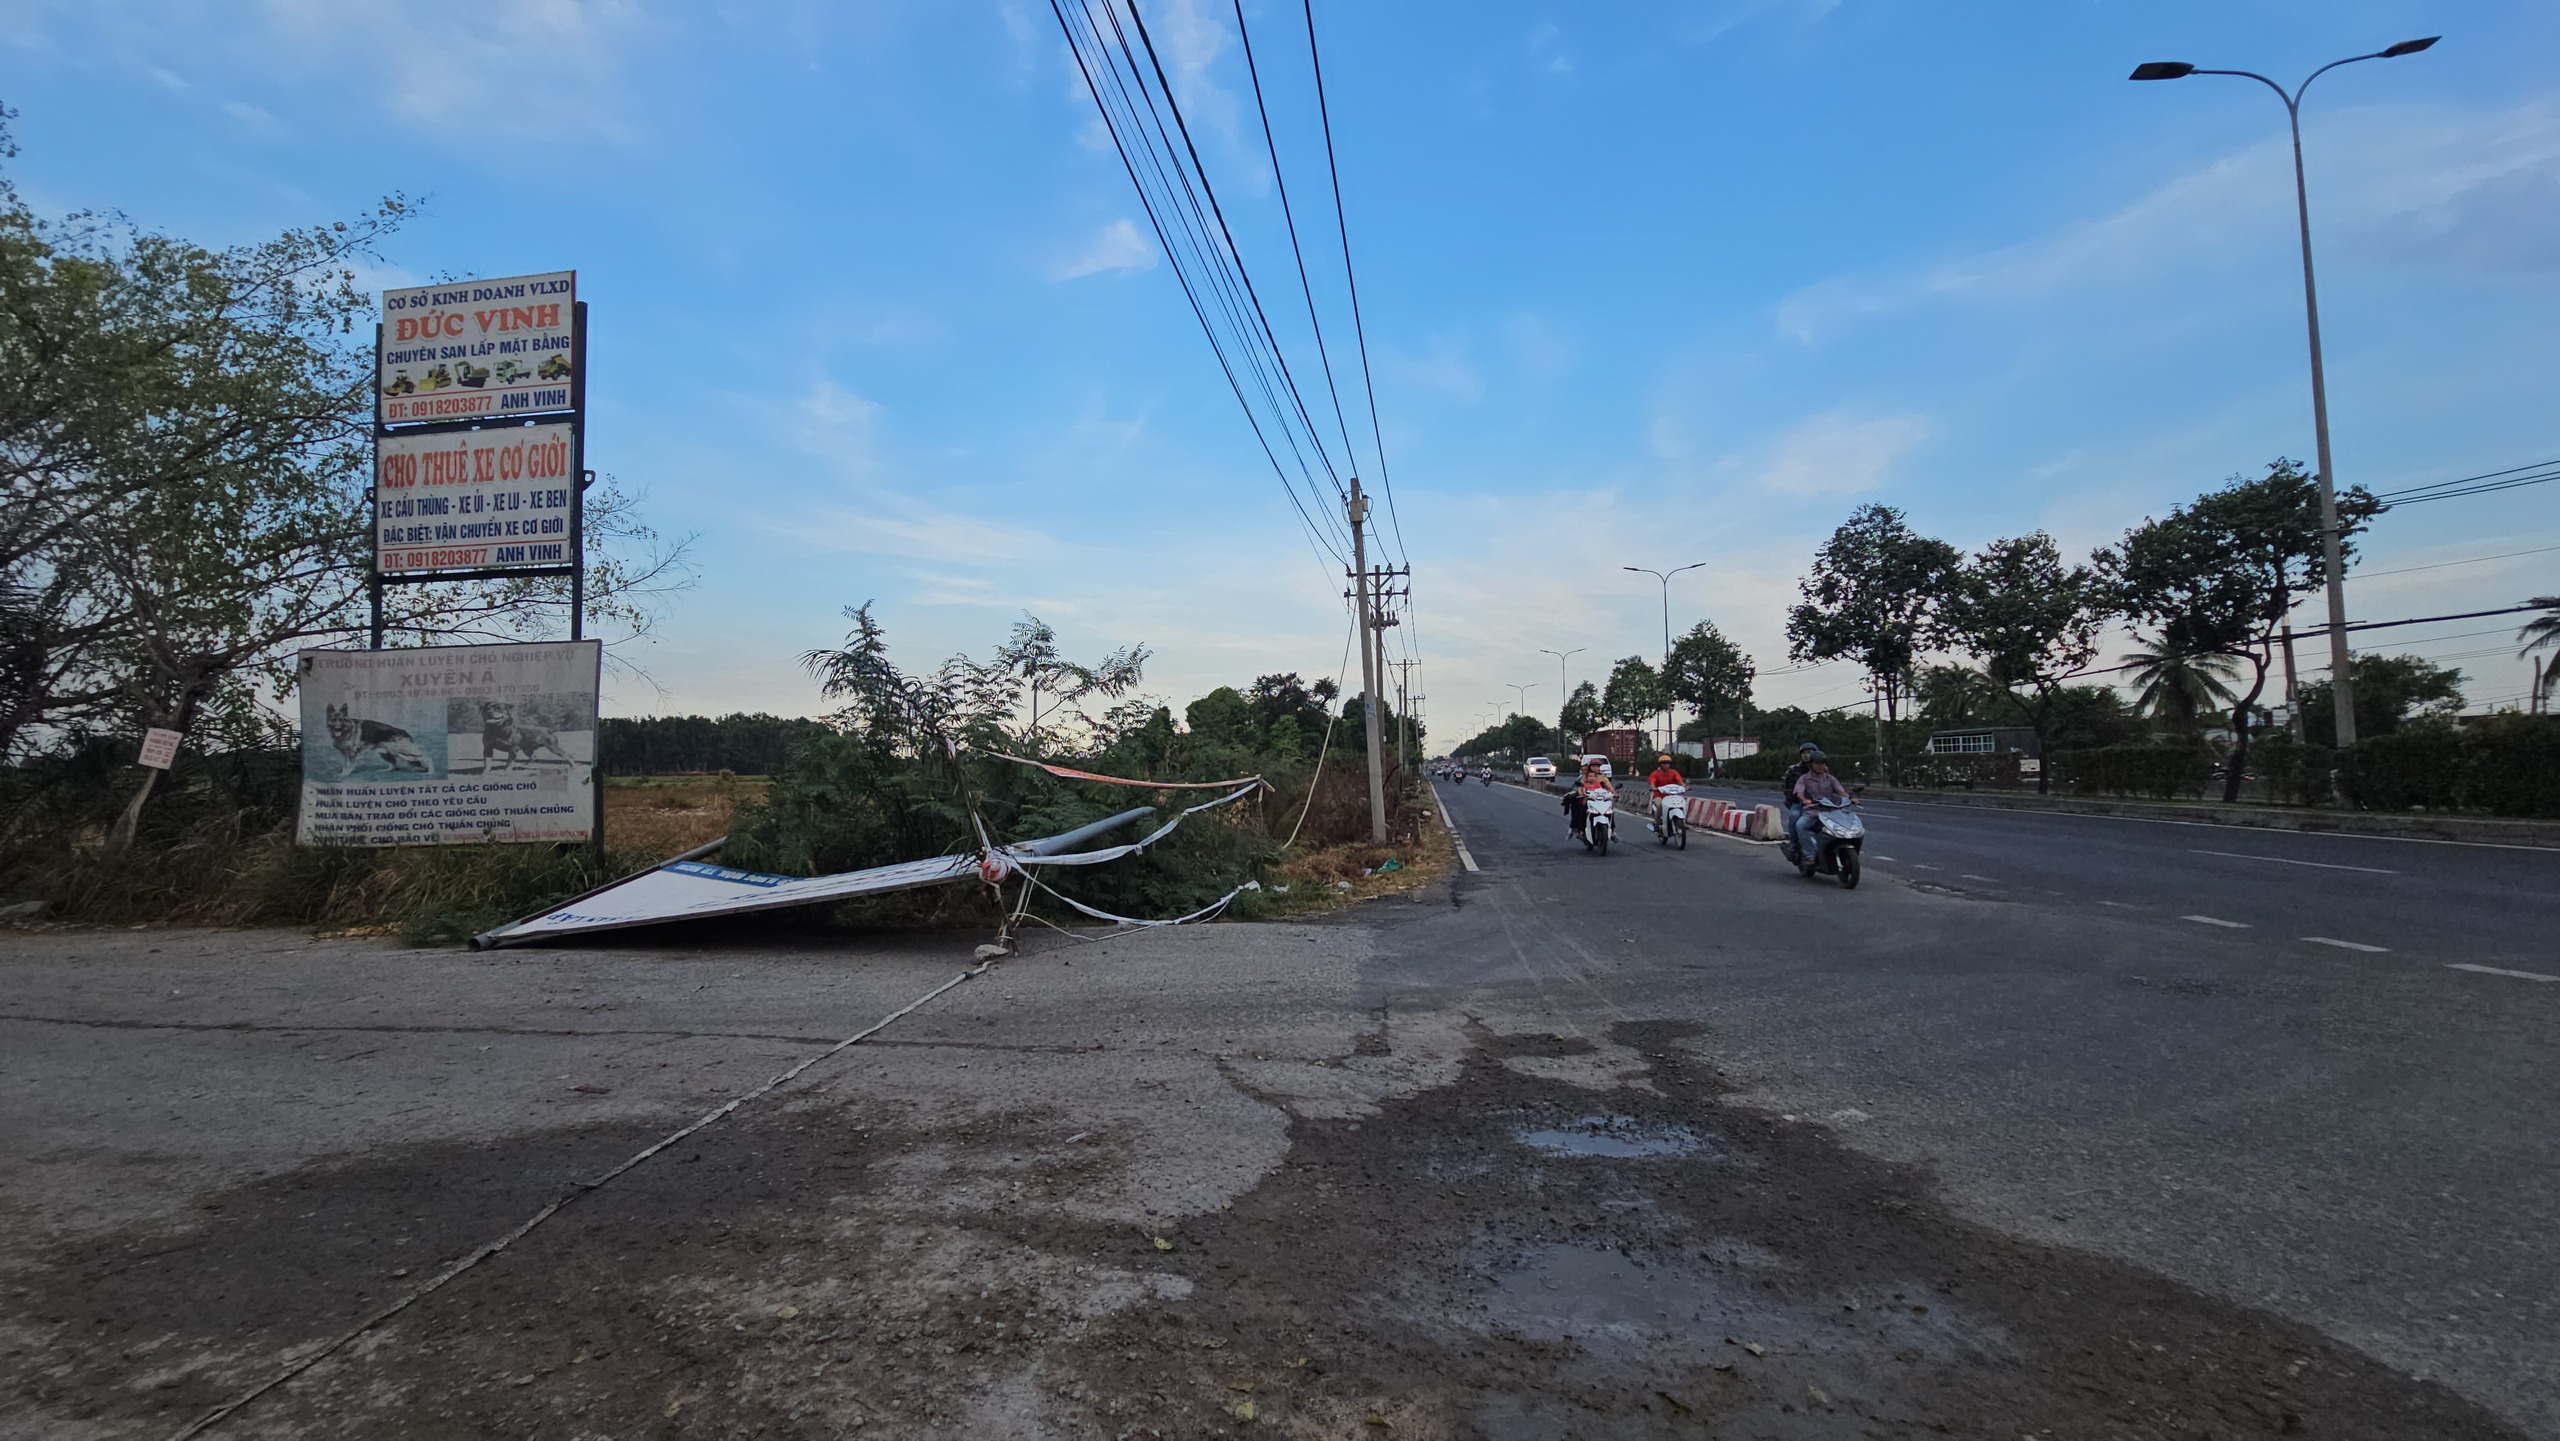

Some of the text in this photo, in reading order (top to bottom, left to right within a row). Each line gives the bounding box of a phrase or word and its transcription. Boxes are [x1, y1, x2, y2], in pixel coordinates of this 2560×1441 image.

[388, 280, 570, 310] CƠ SỞ KINH DOANH VLXD
[396, 303, 560, 341] ĐỨC VINH
[387, 346, 436, 364] CHUYÊN
[441, 344, 466, 359] SAN
[500, 337, 528, 355] MẶT
[533, 332, 570, 351] BẰNG
[389, 389, 566, 418] ĐT: 0918203877 ANH VINH
[384, 432, 567, 488] CHO THUÊ XE CƠ GIỚI
[381, 501, 393, 518] XE
[417, 493, 449, 516] THÙNG
[459, 496, 471, 514] XE
[493, 493, 505, 511] XE
[508, 492, 520, 510] LU
[530, 491, 543, 509] XE
[546, 489, 567, 508] BEN
[435, 521, 457, 543] VẬN
[505, 521, 519, 536] XE
[522, 518, 538, 535] CƠ
[541, 515, 563, 534] GIỚI
[384, 544, 562, 568] ĐT: 0918203877 ANH VINH
[401, 668, 473, 687] XUYÊN
[516, 781, 537, 791] CHÓ
[315, 812, 338, 820] MUA
[366, 812, 395, 820] TRAO
[385, 799, 407, 808] CHÓ
[411, 798, 439, 807] THEO
